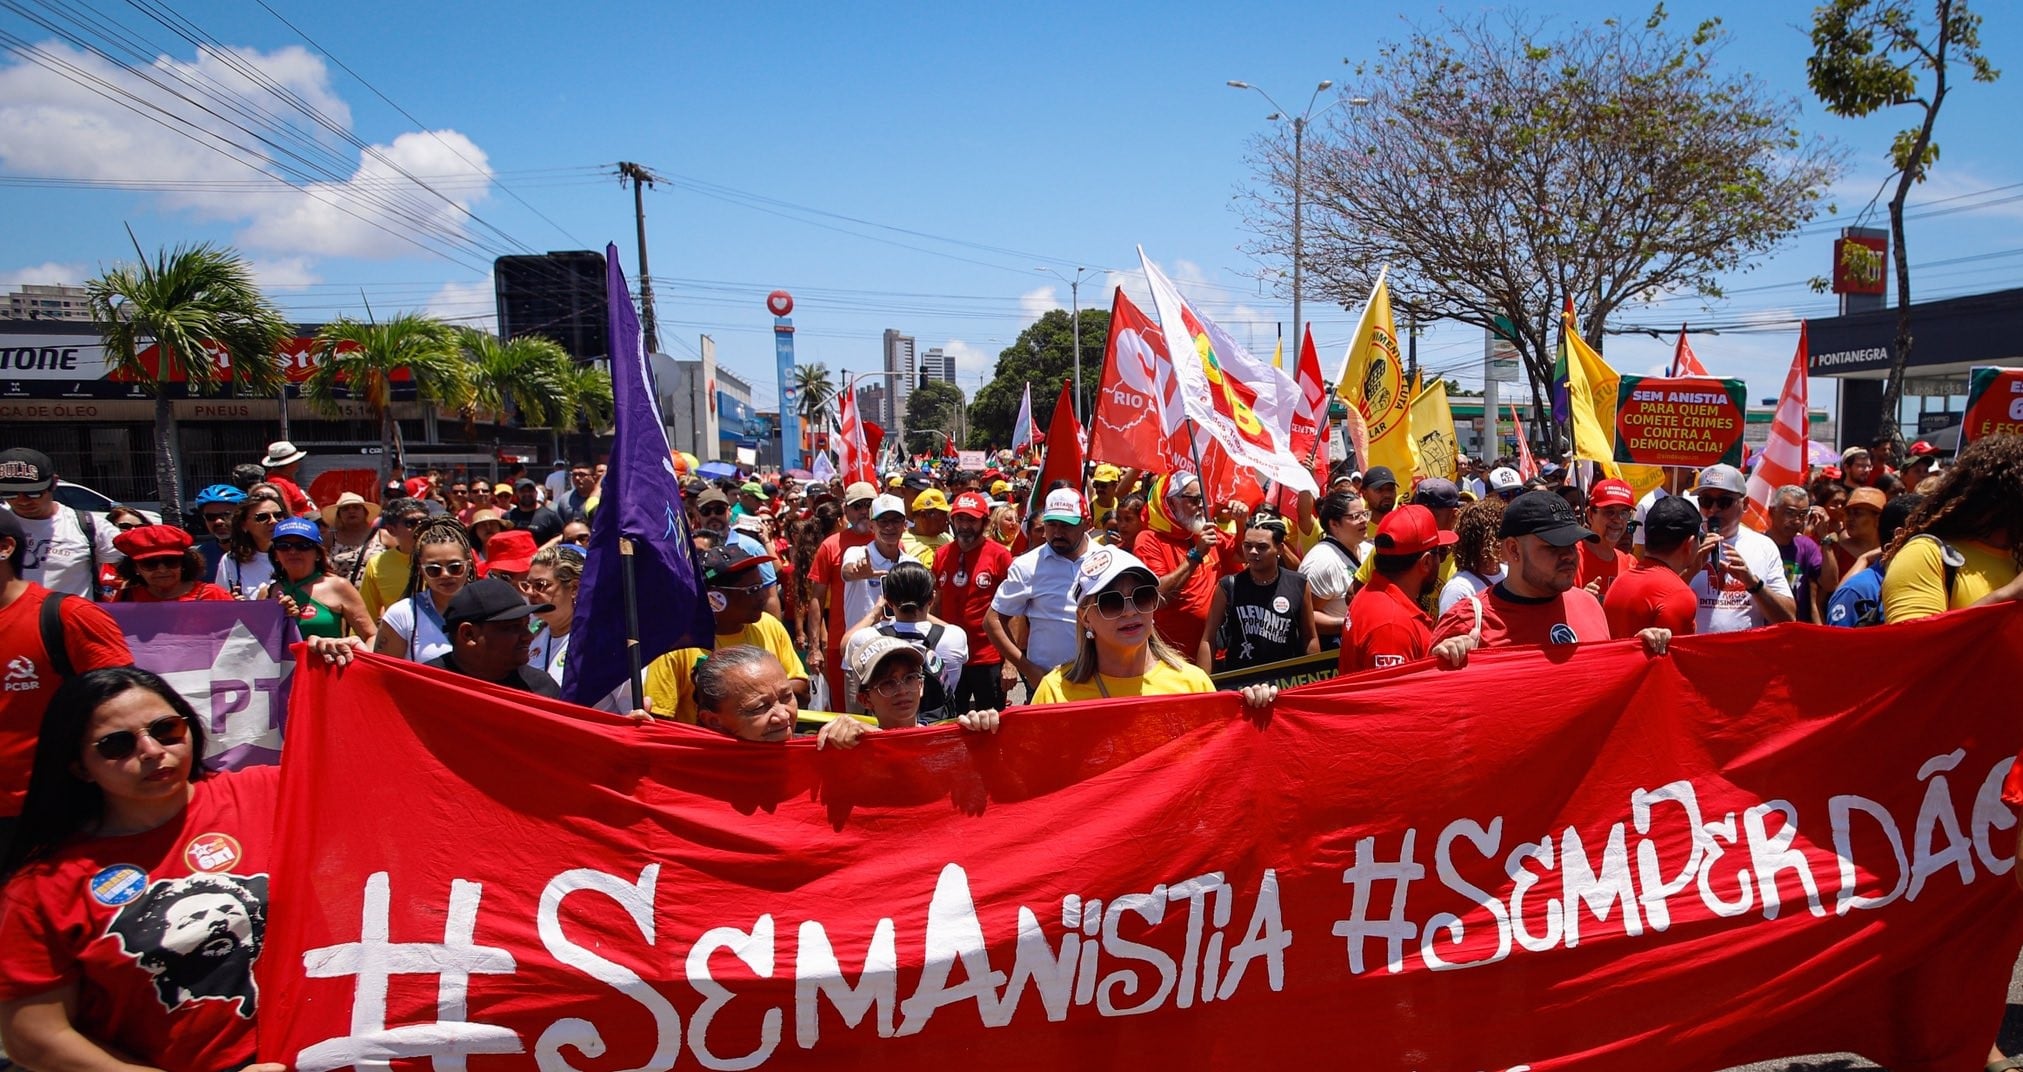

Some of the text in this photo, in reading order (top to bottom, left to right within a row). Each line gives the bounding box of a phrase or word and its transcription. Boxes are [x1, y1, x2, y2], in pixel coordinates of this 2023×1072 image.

[1818, 348, 1888, 366] PONTANEGRA
[784, 367, 797, 417] GLOBO
[1632, 391, 1728, 405] SEM ANISTIA
[1114, 391, 1143, 409] RIO
[28, 406, 49, 417] DE
[53, 403, 97, 417] ÓLEO
[195, 405, 249, 415] PNEUS
[1640, 403, 1719, 417] PARA QUEM
[1624, 414, 1733, 430] COMETE CRIMES
[1643, 427, 1711, 440] CONTRA A
[1630, 438, 1723, 453] DEMOCRACIA!
[0, 461, 38, 480] BULLS
[1239, 605, 1291, 632] LEVANTE
[1377, 656, 1402, 666] CUT
[5, 681, 39, 692] PCBR
[210, 677, 280, 734] PT
